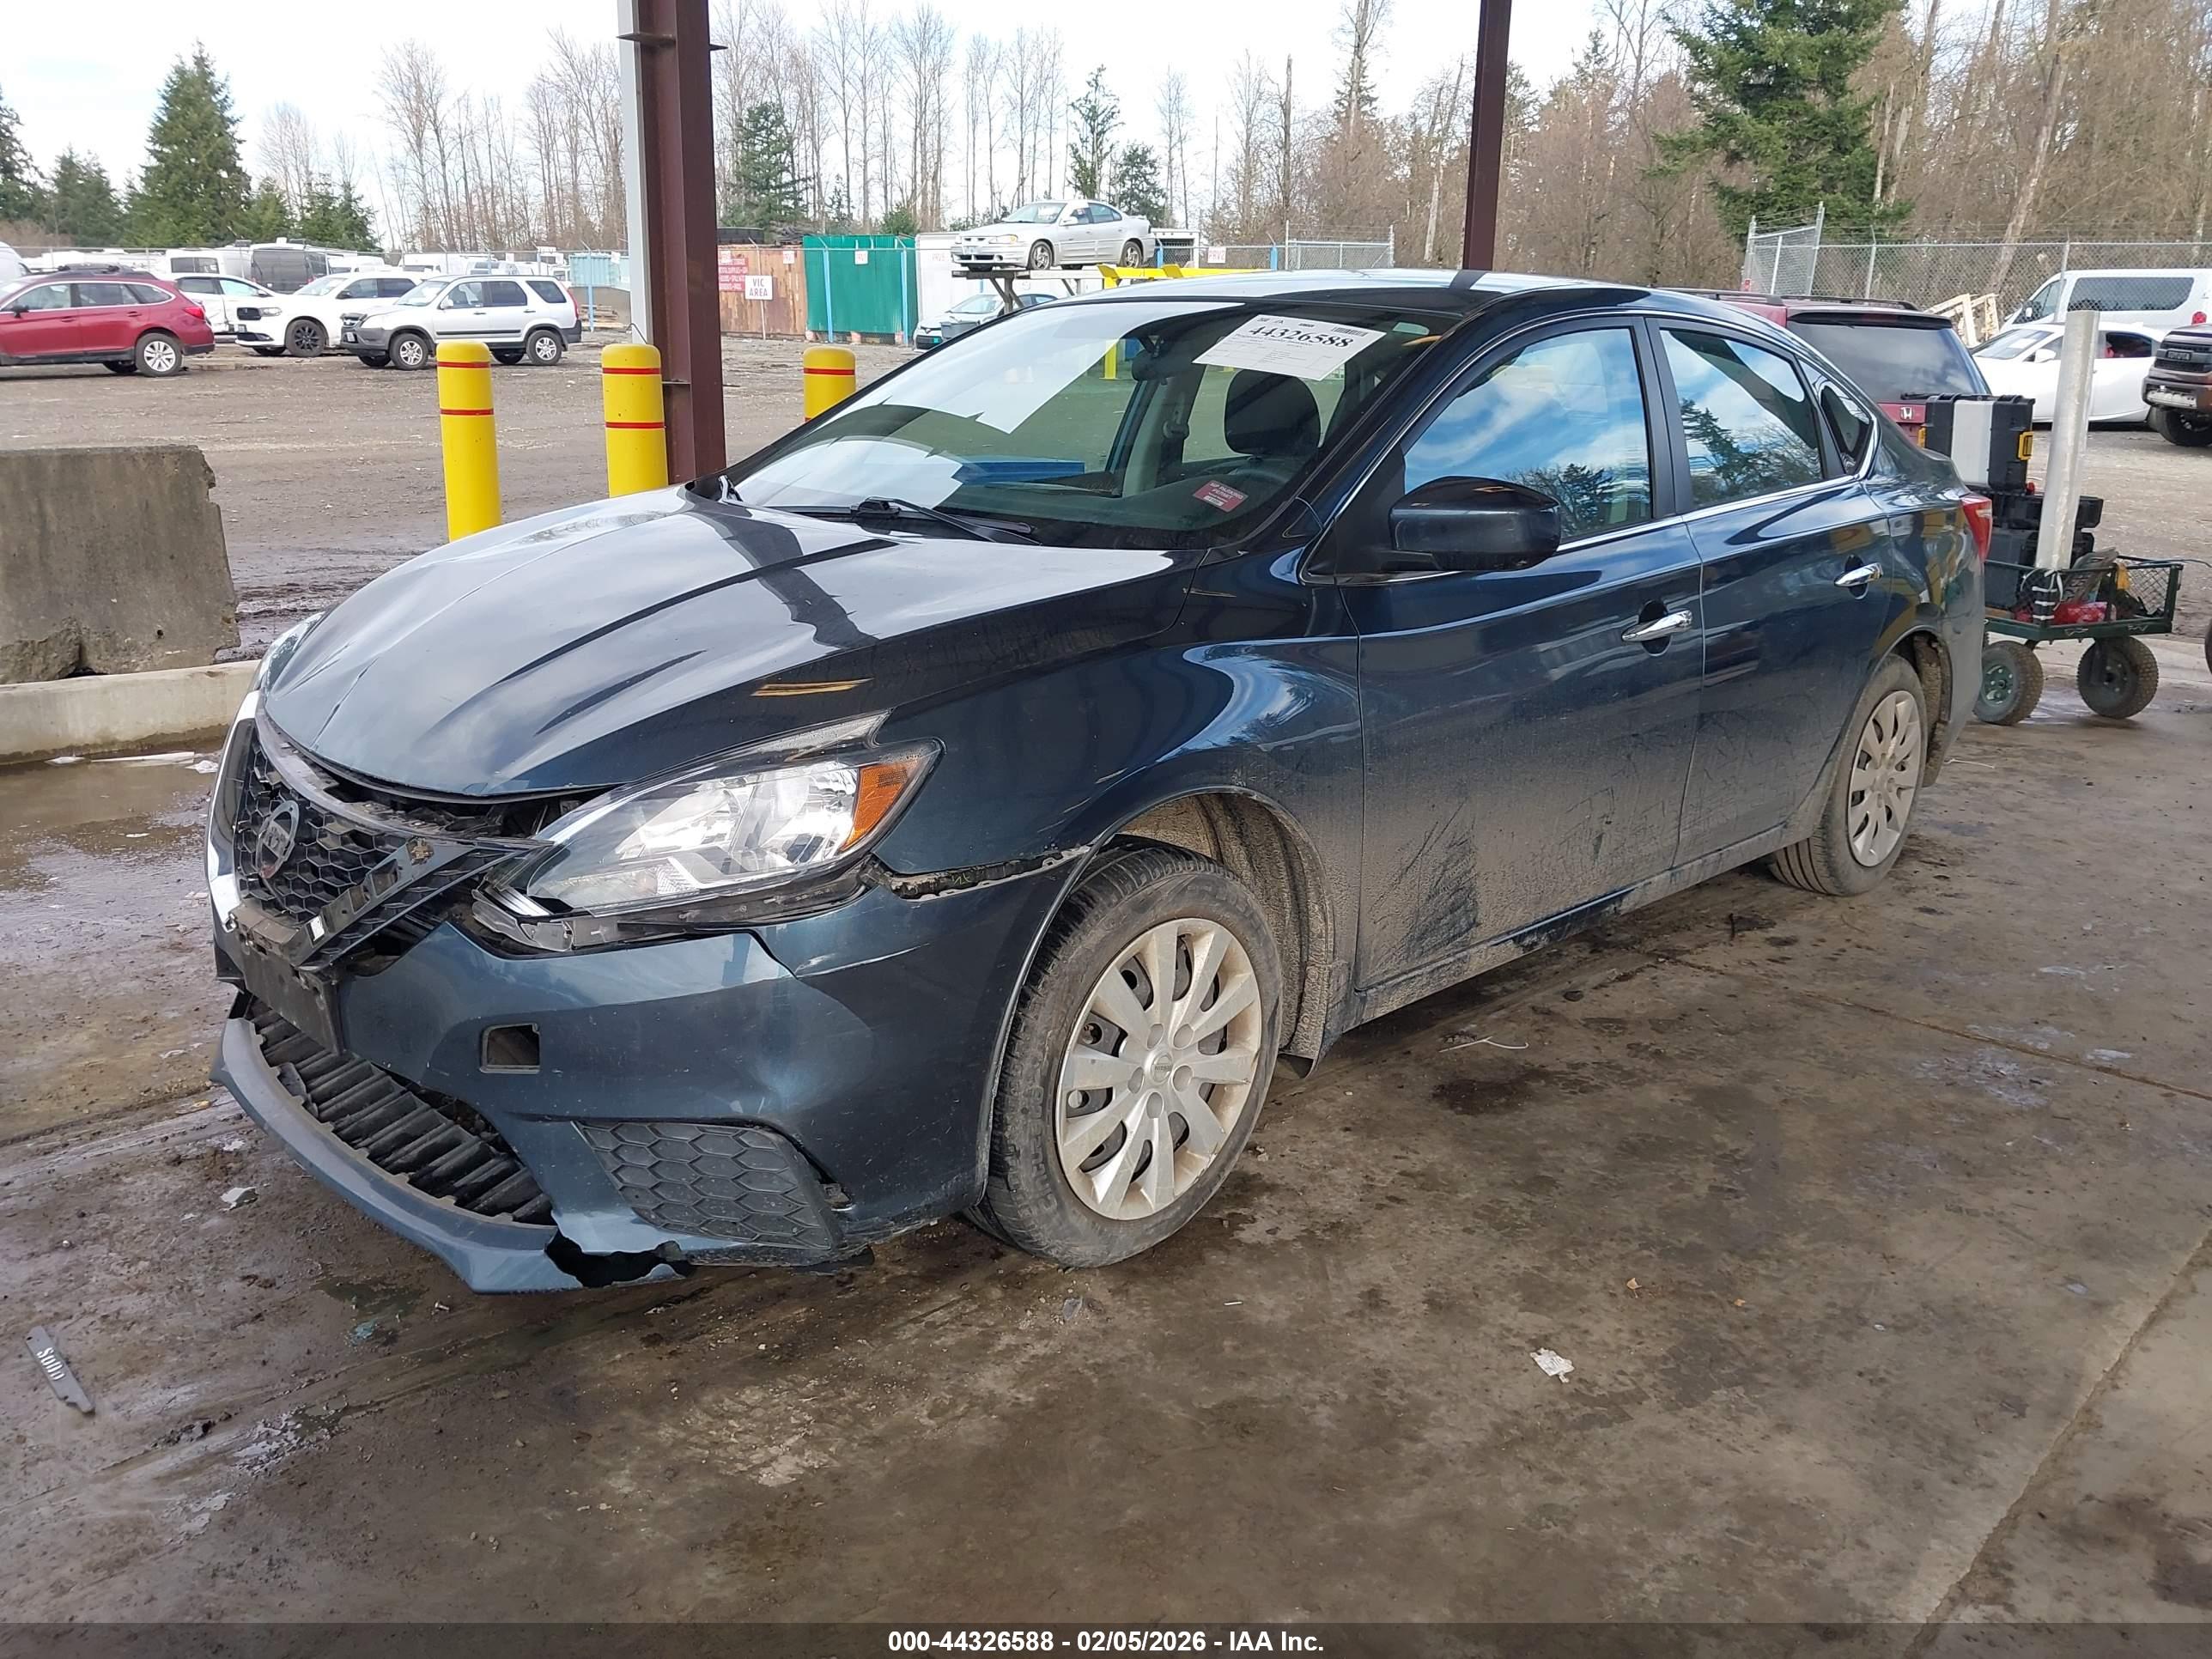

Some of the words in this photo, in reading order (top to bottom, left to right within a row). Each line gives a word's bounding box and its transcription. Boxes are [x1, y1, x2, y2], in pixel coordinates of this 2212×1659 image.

[752, 277, 765, 287] VIC
[749, 288, 768, 297] AREA
[1248, 325, 1354, 348] 44326588
